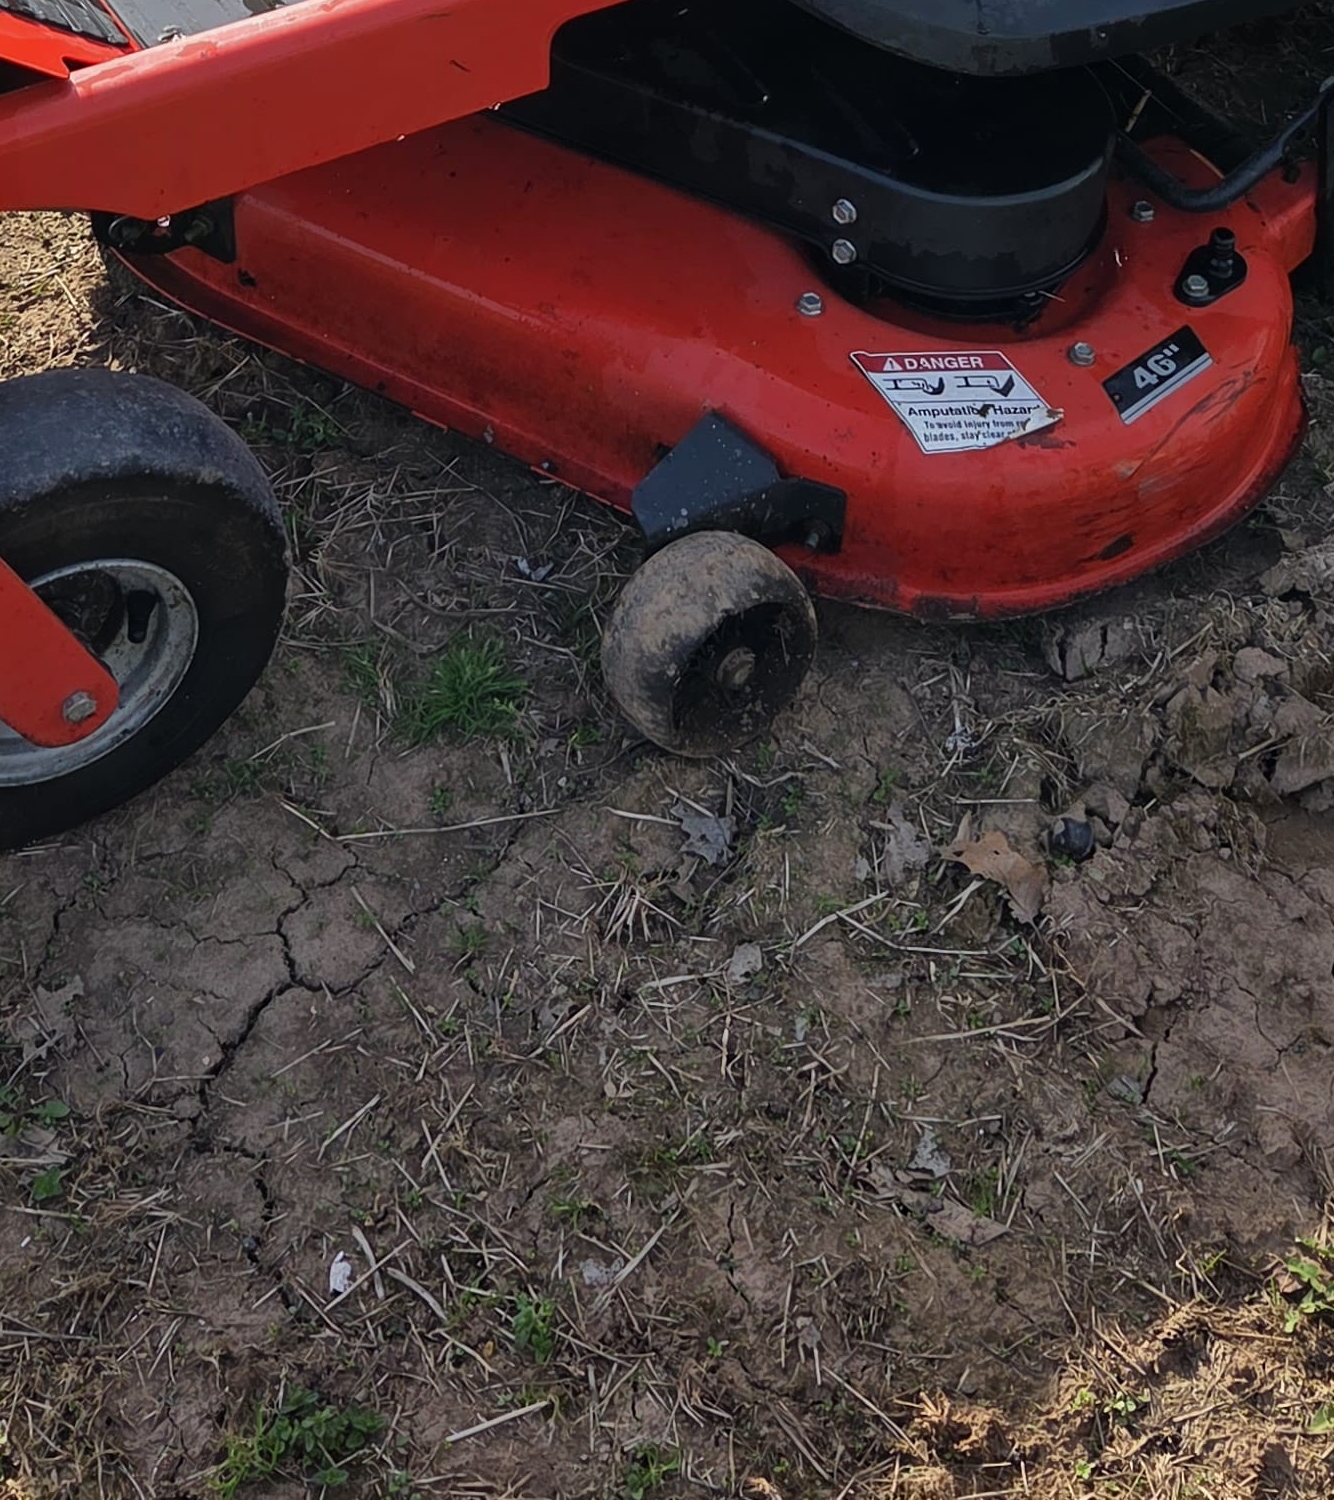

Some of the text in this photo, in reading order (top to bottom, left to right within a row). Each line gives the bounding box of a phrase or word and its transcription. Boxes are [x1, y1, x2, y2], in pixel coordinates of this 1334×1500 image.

[904, 356, 985, 370] DANGER
[908, 403, 1039, 419] Amputatio Hazar
[923, 420, 935, 429] To
[992, 419, 1014, 428] from
[923, 431, 959, 442] blades,
[961, 430, 980, 441] stay
[981, 430, 1005, 439] clear
